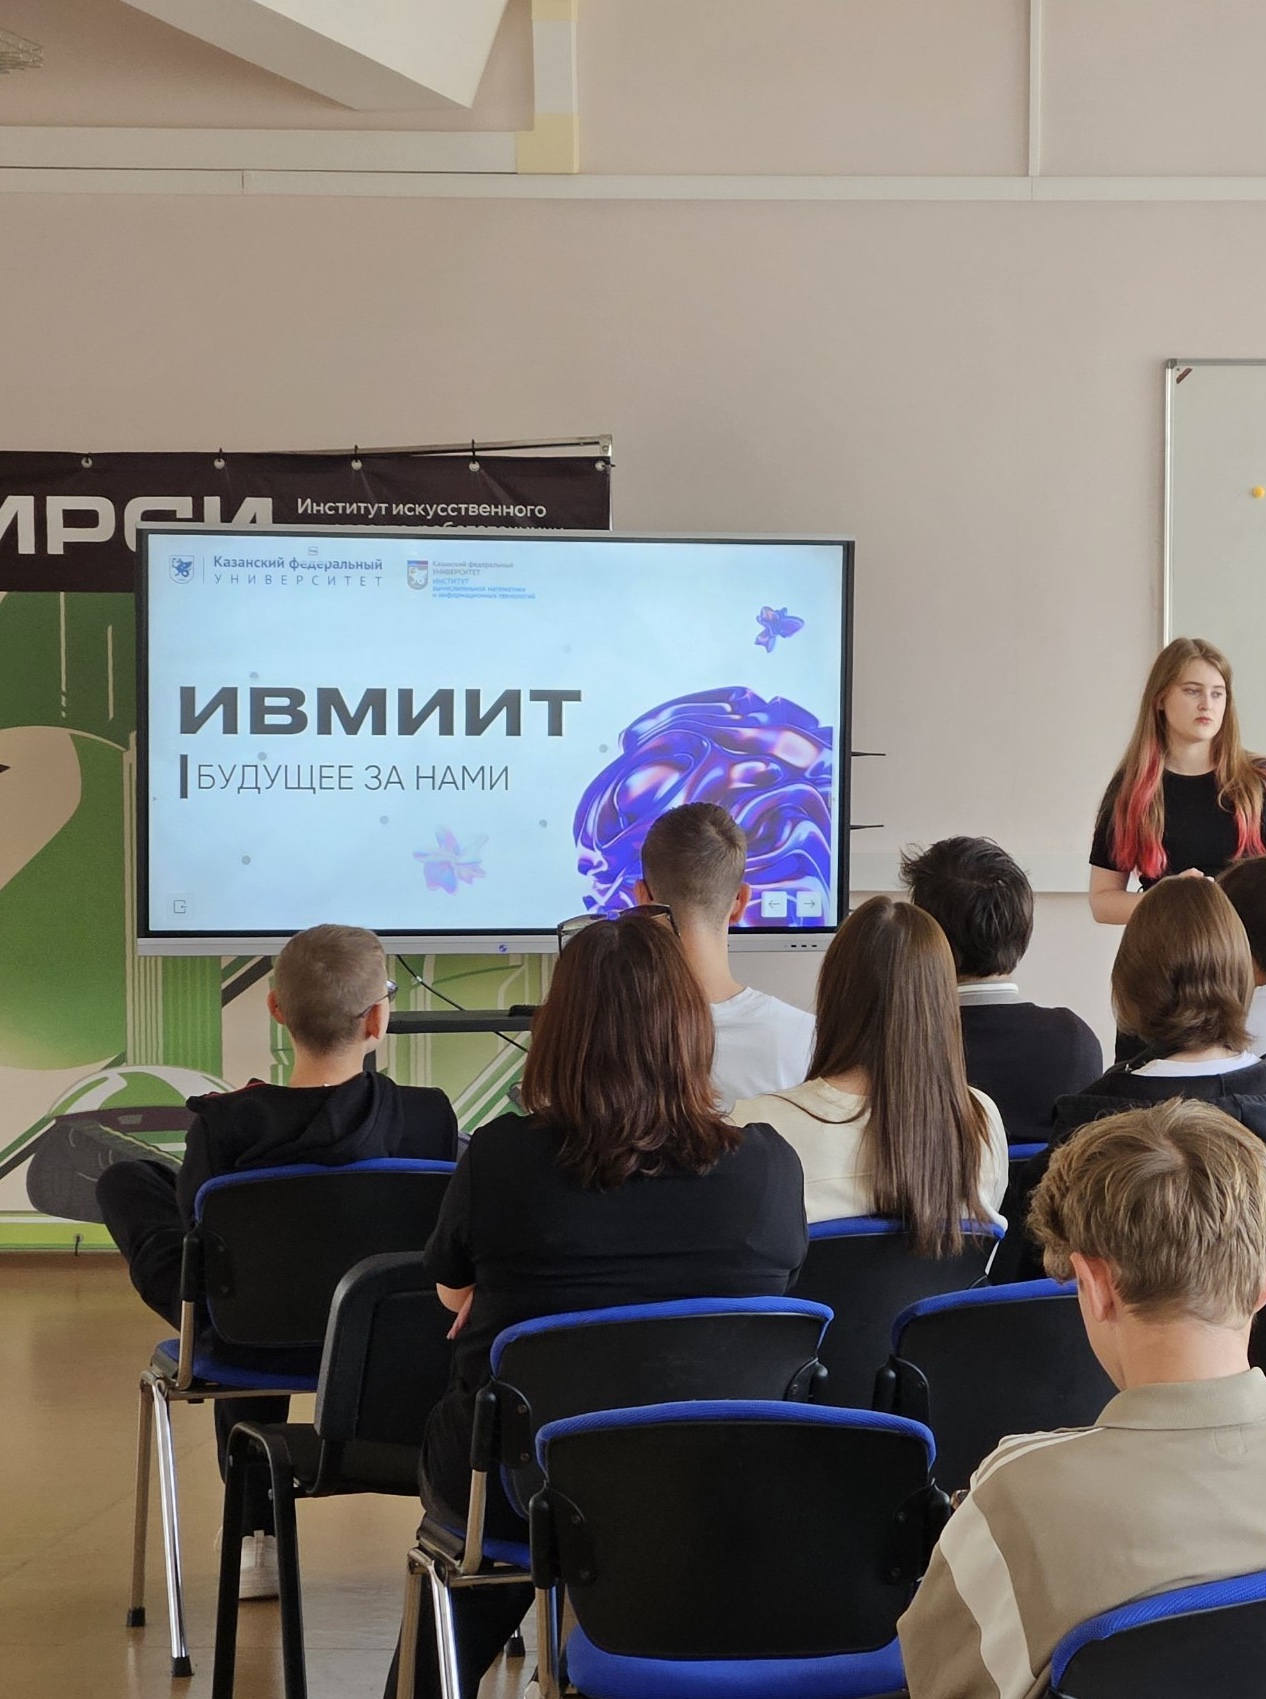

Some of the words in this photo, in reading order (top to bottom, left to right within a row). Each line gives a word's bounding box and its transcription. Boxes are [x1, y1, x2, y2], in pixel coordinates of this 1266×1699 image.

[297, 498, 389, 519] Институт
[393, 502, 547, 519] искусственного
[213, 555, 285, 569] Казанский
[289, 556, 383, 572] федеральный
[214, 573, 384, 587] УНИВЕРСИТЕТ
[179, 685, 583, 737] ИВМИИТ
[197, 764, 354, 794] БУДУЩЕЕ
[364, 765, 405, 791] ЗА
[416, 765, 510, 791] НАМИ
